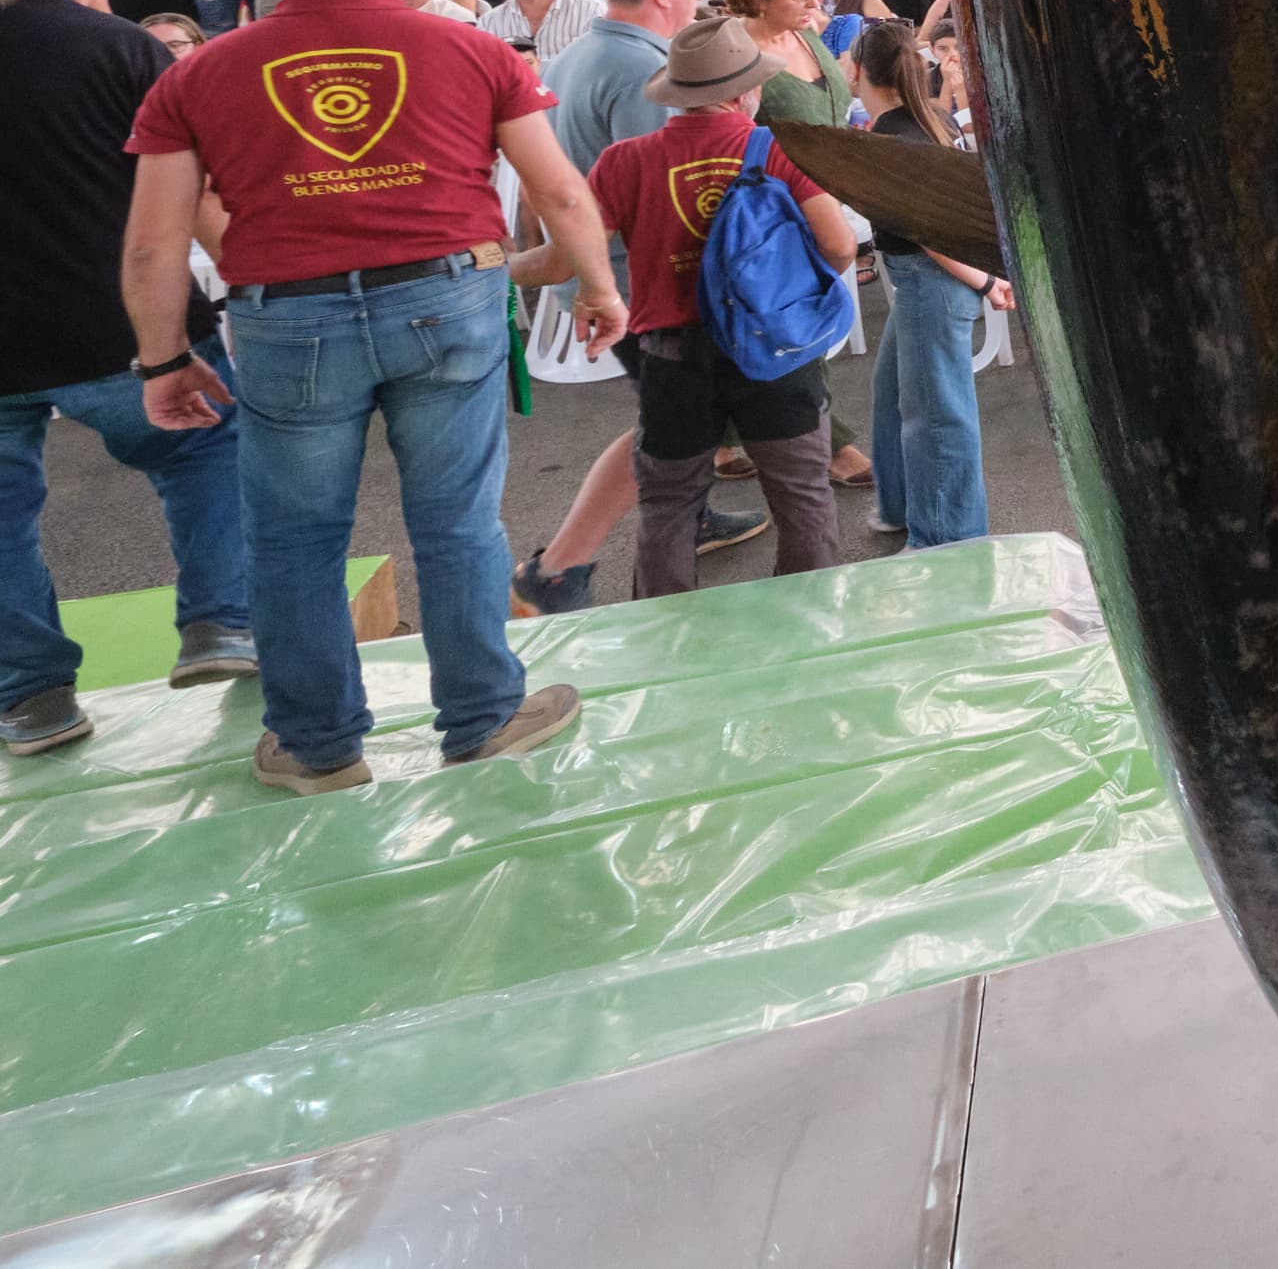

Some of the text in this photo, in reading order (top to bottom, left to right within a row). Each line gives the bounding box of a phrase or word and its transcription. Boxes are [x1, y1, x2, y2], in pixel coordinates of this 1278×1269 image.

[285, 62, 385, 78] SEGURMAXIMO
[283, 161, 427, 184] SU SEGURIDAD EN
[292, 175, 424, 197] BUENAS MANOS
